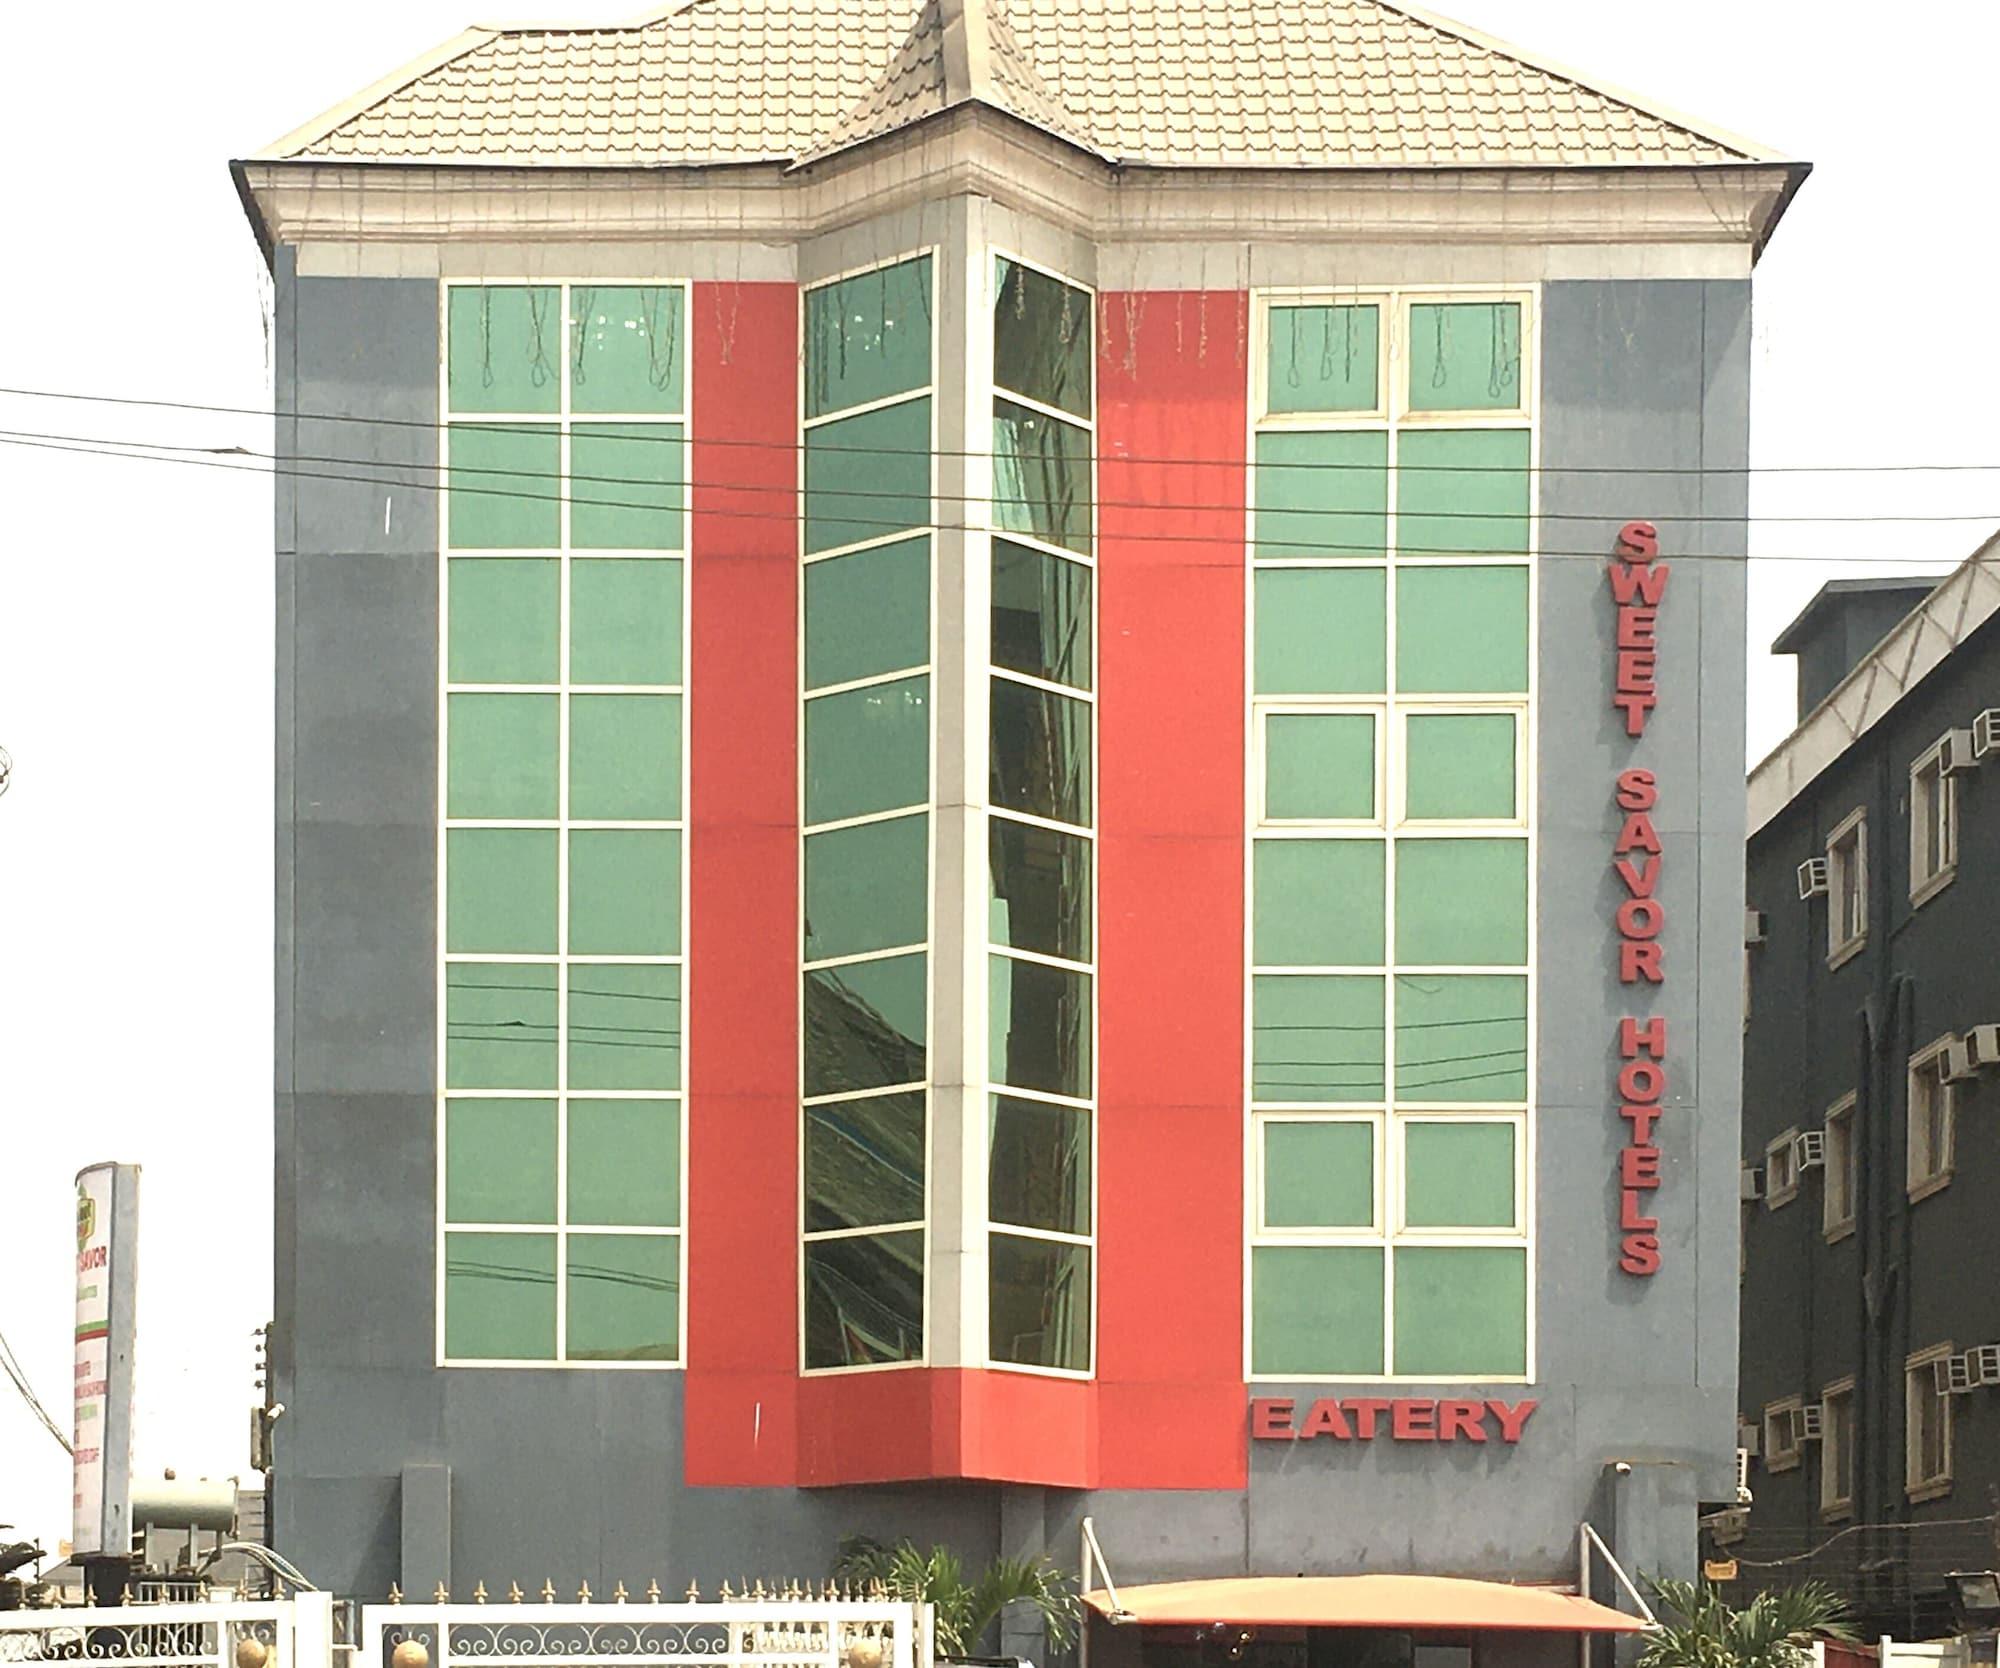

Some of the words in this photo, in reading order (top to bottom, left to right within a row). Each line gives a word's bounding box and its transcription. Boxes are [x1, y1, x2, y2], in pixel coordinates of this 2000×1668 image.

[1609, 521, 1670, 738] SWEET
[1613, 768, 1663, 983] SAVOR
[1618, 1017, 1666, 1276] HOTELS
[1251, 1397, 1537, 1442] EATERY
